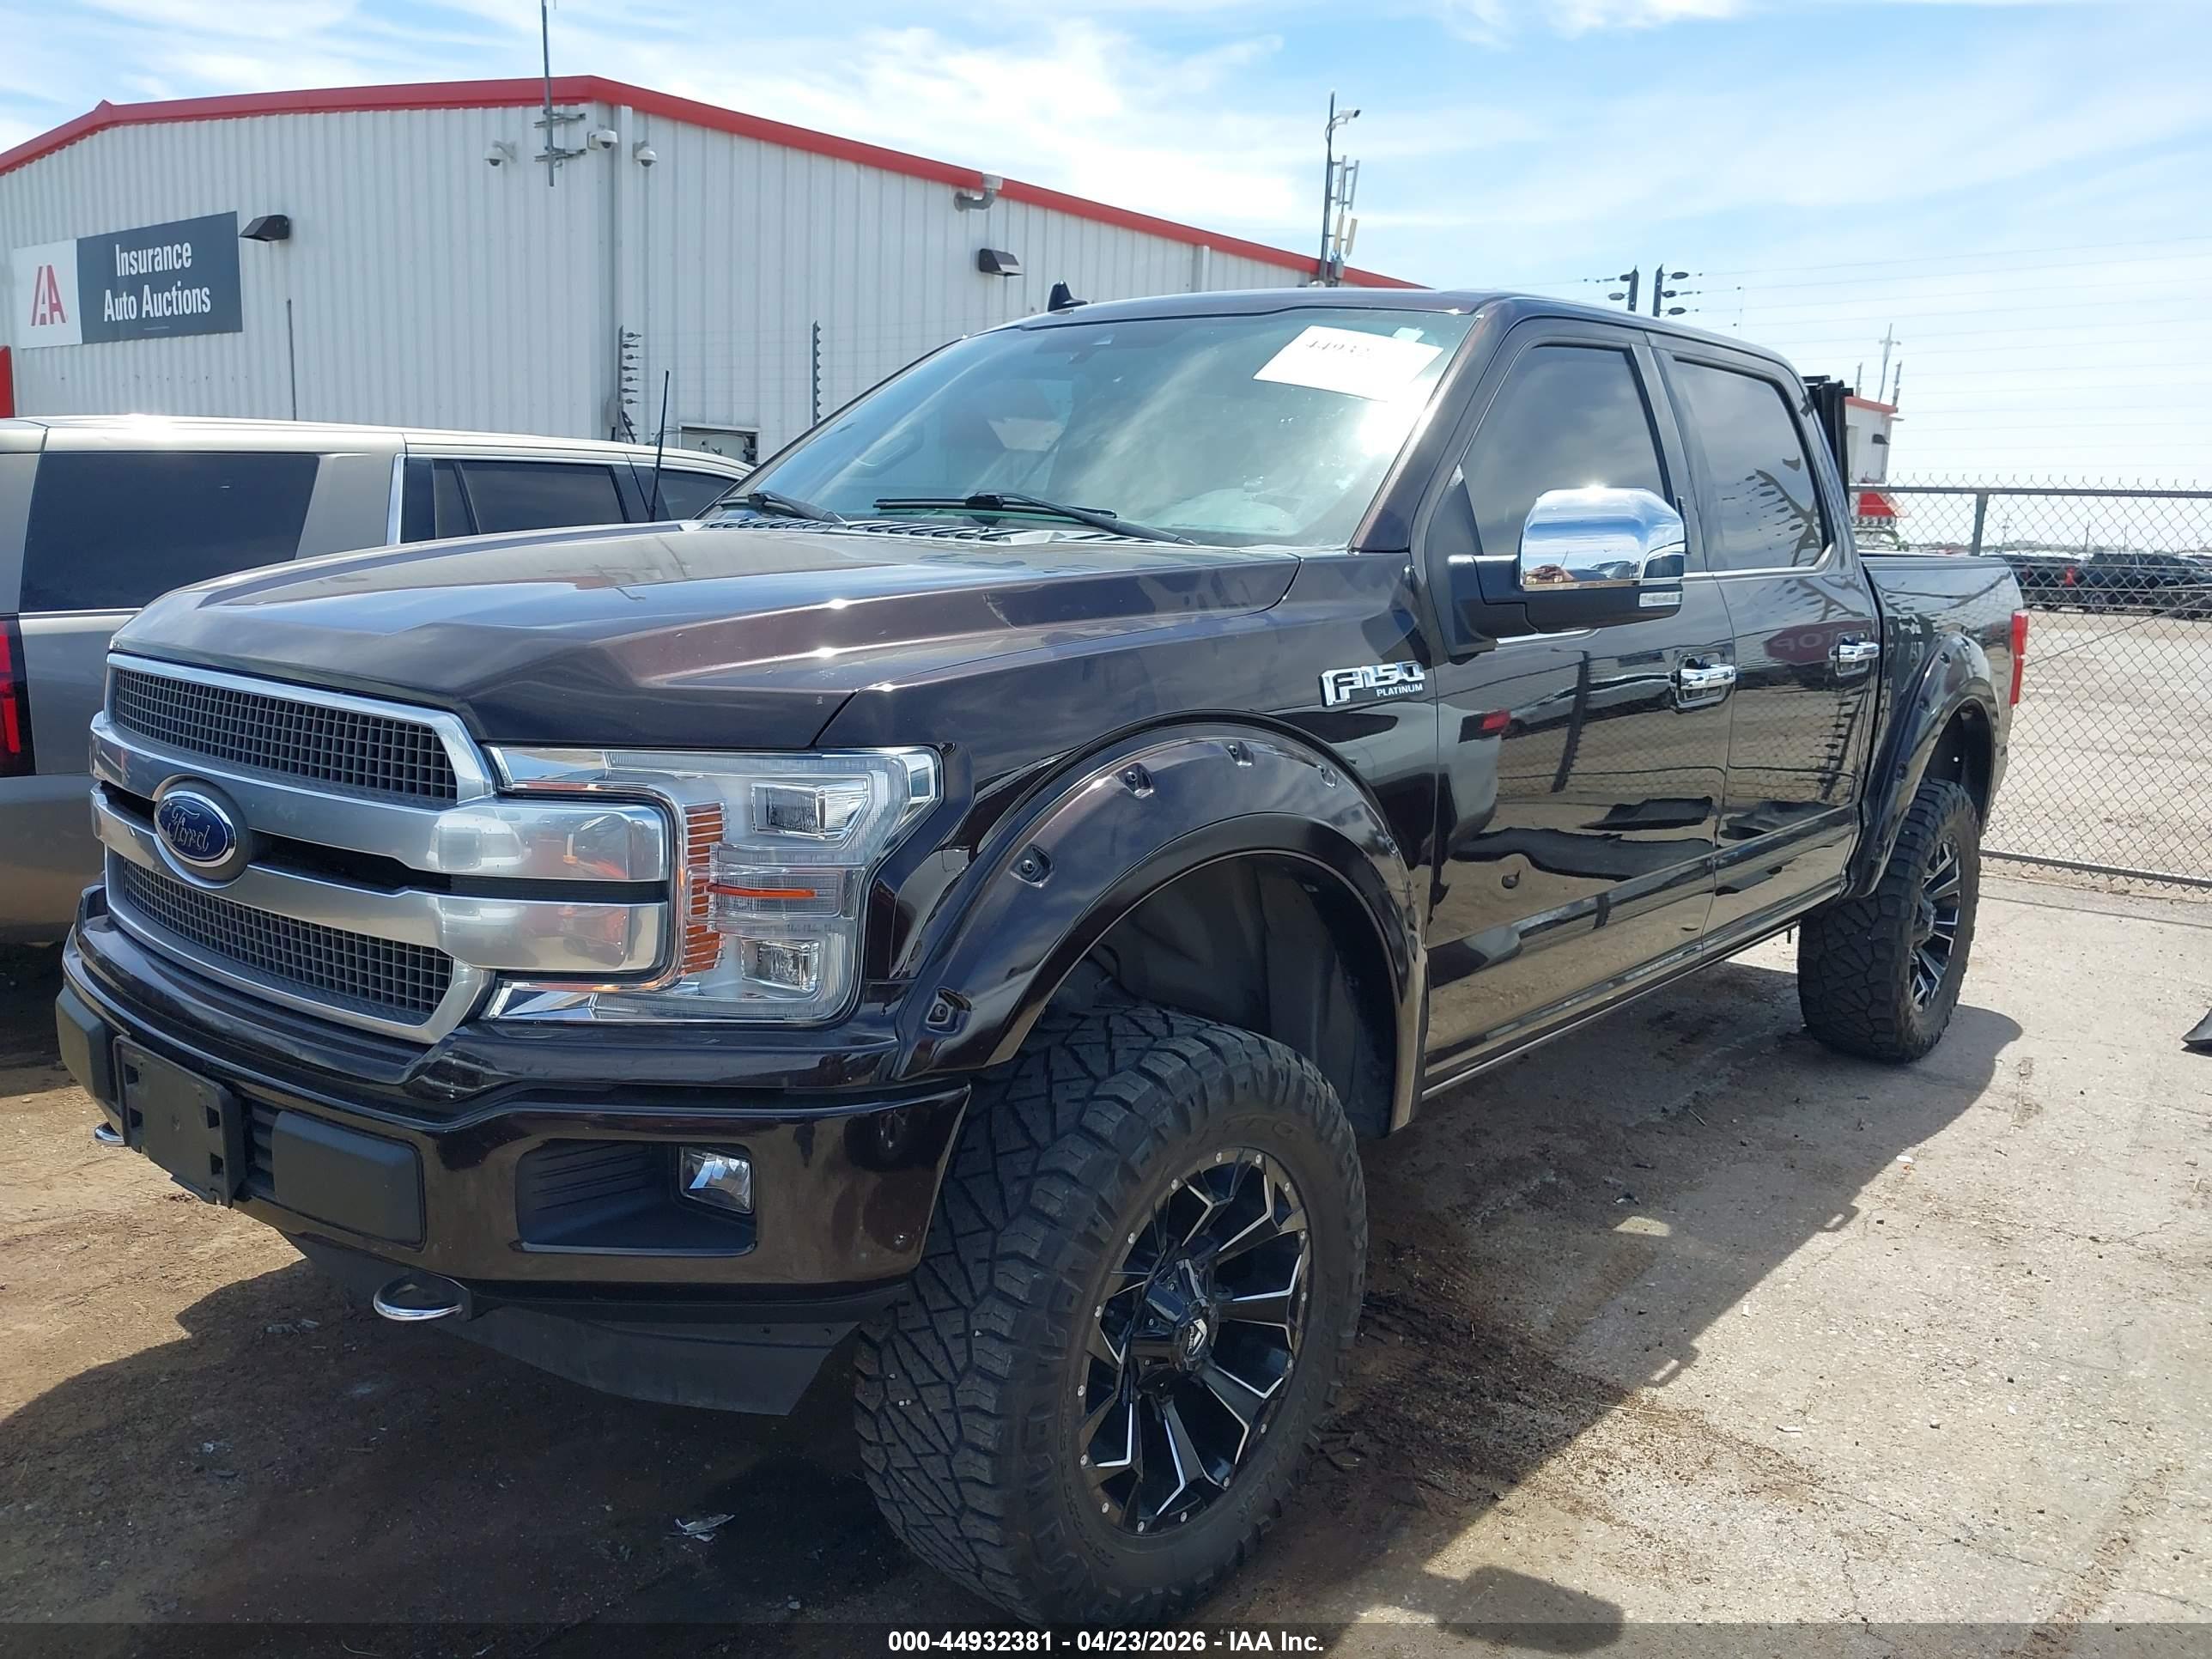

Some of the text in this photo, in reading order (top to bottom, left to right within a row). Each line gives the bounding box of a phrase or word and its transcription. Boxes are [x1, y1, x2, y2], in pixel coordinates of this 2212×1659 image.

[115, 241, 192, 276] Insurance
[103, 281, 211, 322] Auto Auctions
[1376, 684, 1424, 697] PLATINUM
[167, 805, 211, 853] Ford
[1186, 1325, 1195, 1354] FUEL
